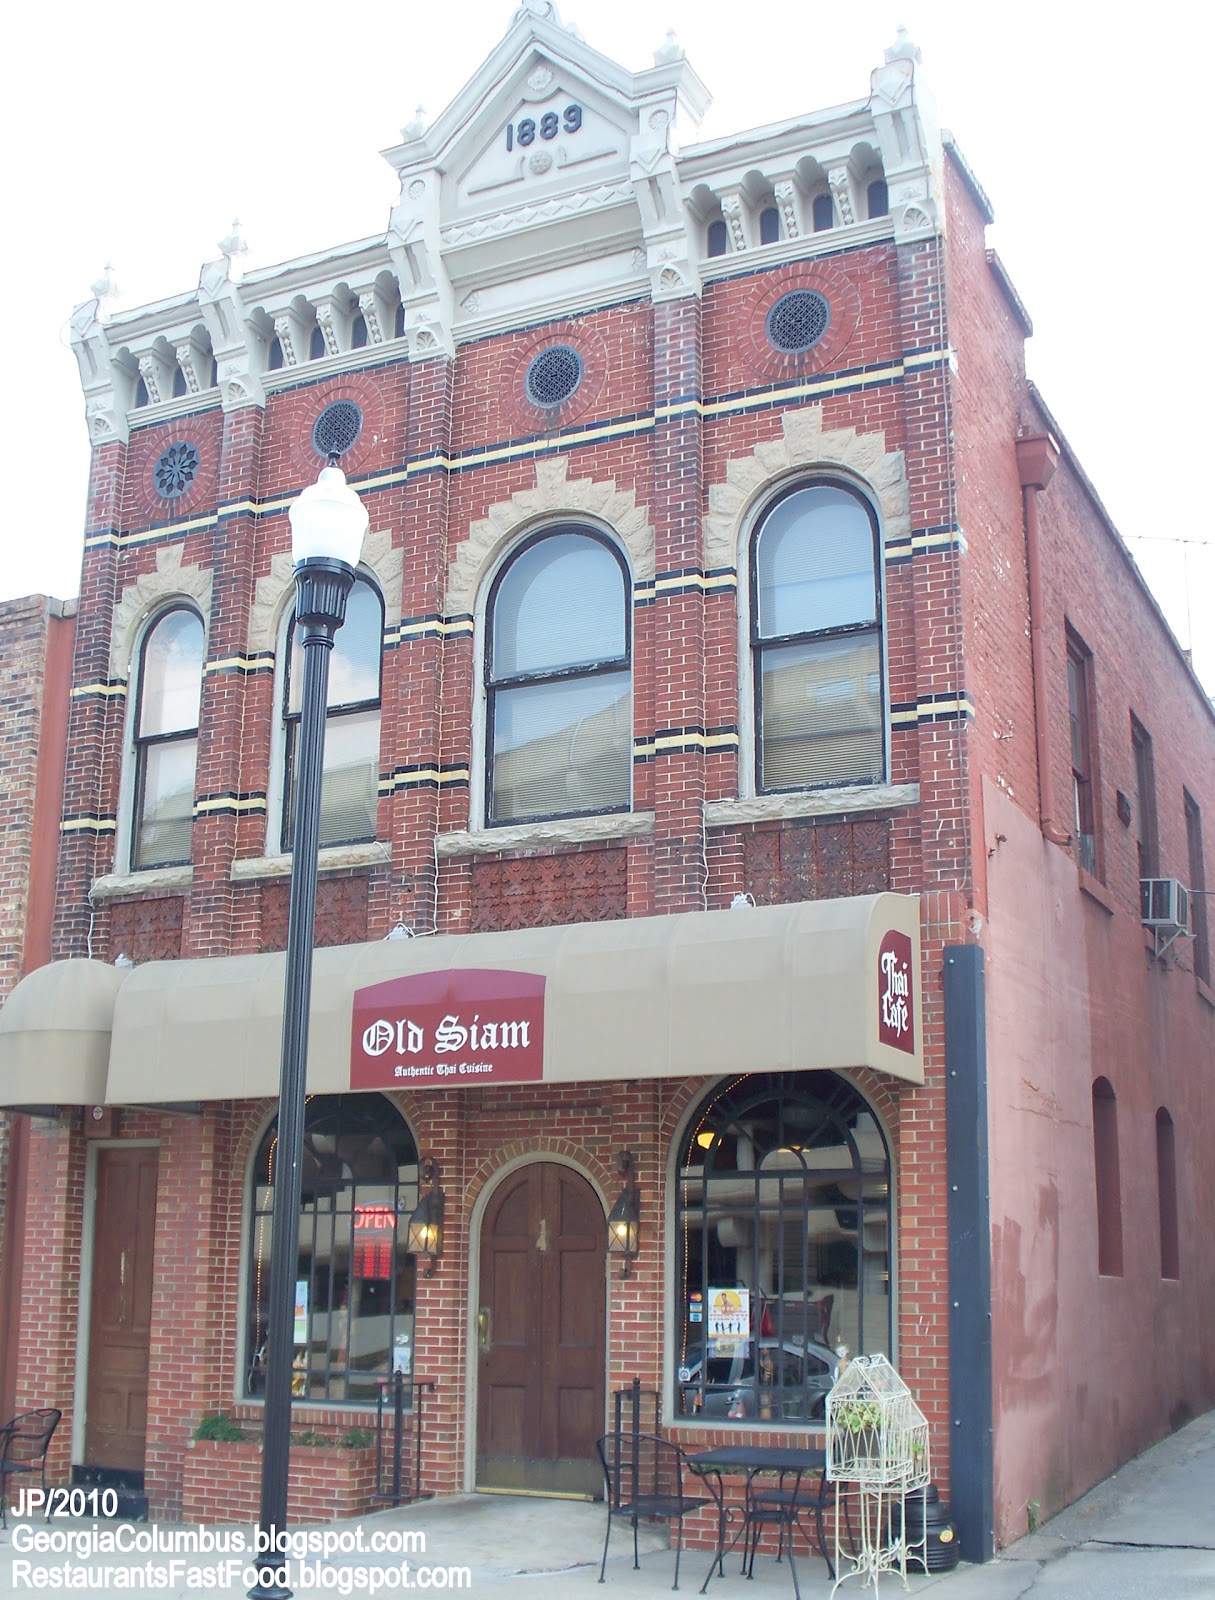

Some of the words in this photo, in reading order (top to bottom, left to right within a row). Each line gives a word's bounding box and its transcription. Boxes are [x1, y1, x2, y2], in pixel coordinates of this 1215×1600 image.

[506, 104, 582, 152] 1889
[881, 951, 908, 997] Thai
[362, 1019, 424, 1057] Old
[434, 1015, 531, 1054] Siam
[882, 990, 908, 1038] Cafe
[394, 1065, 434, 1077] Authentic
[436, 1064, 457, 1075] Thai
[459, 1062, 493, 1075] Cuisine
[350, 1206, 396, 1229] OPEN
